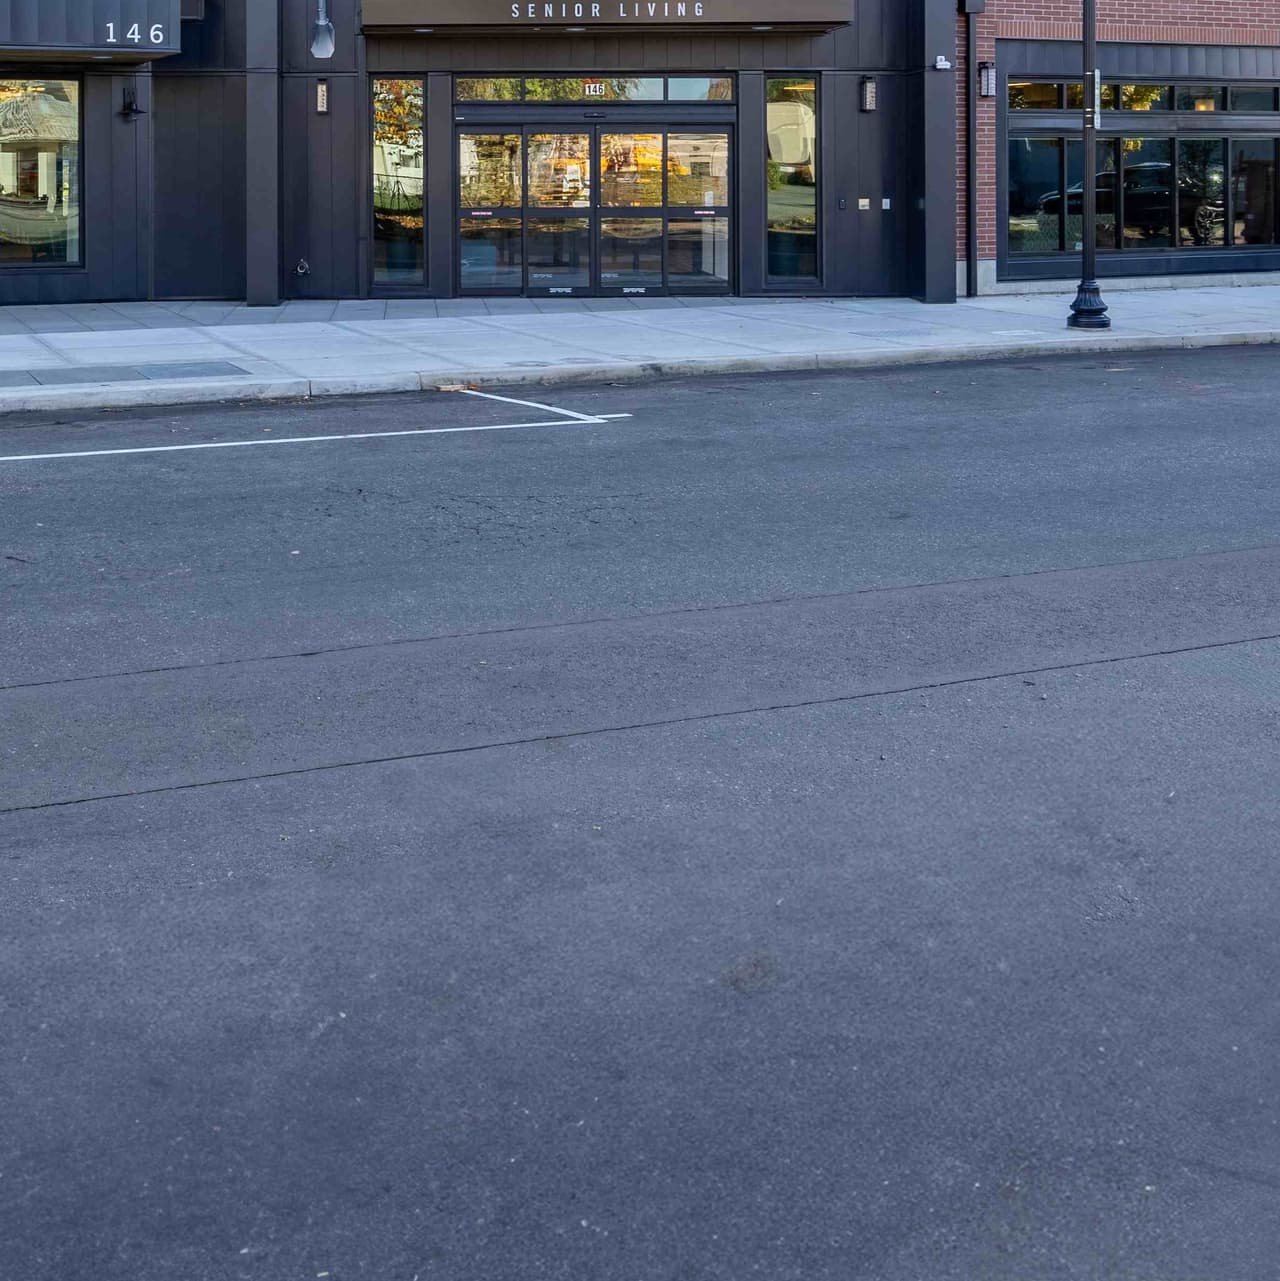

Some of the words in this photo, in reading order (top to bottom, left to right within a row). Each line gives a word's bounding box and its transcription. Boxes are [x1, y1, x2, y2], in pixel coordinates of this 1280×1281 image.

[511, 3, 600, 18] SENIOR
[619, 2, 704, 18] LIVING
[105, 22, 164, 44] 146
[587, 84, 604, 94] 146
